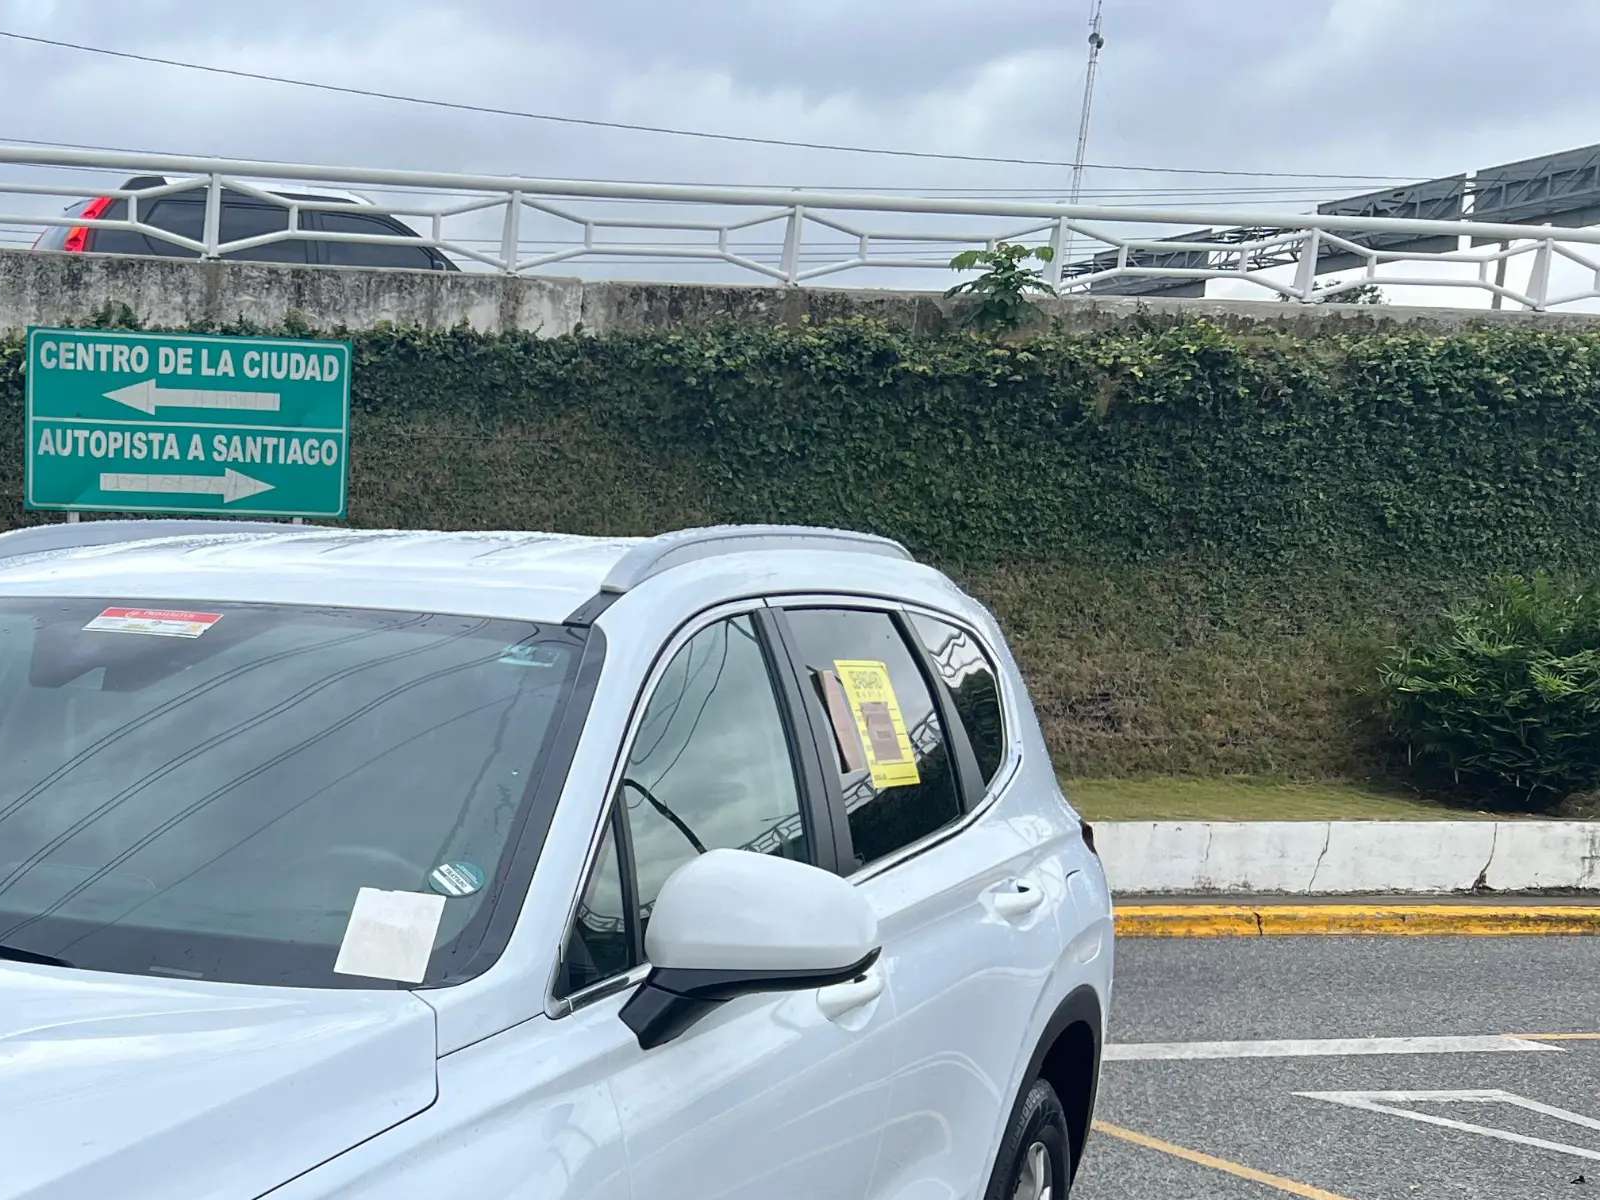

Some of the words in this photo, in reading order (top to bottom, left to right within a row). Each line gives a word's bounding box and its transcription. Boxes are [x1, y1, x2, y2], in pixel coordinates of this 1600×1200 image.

[40, 341, 149, 373] CENTRO
[158, 346, 192, 375] DE
[201, 348, 235, 377] LA
[243, 351, 339, 382] CIUDAD
[38, 428, 180, 460] AUTOPISTA
[187, 434, 205, 461] A
[212, 435, 338, 466] SANTIAGO
